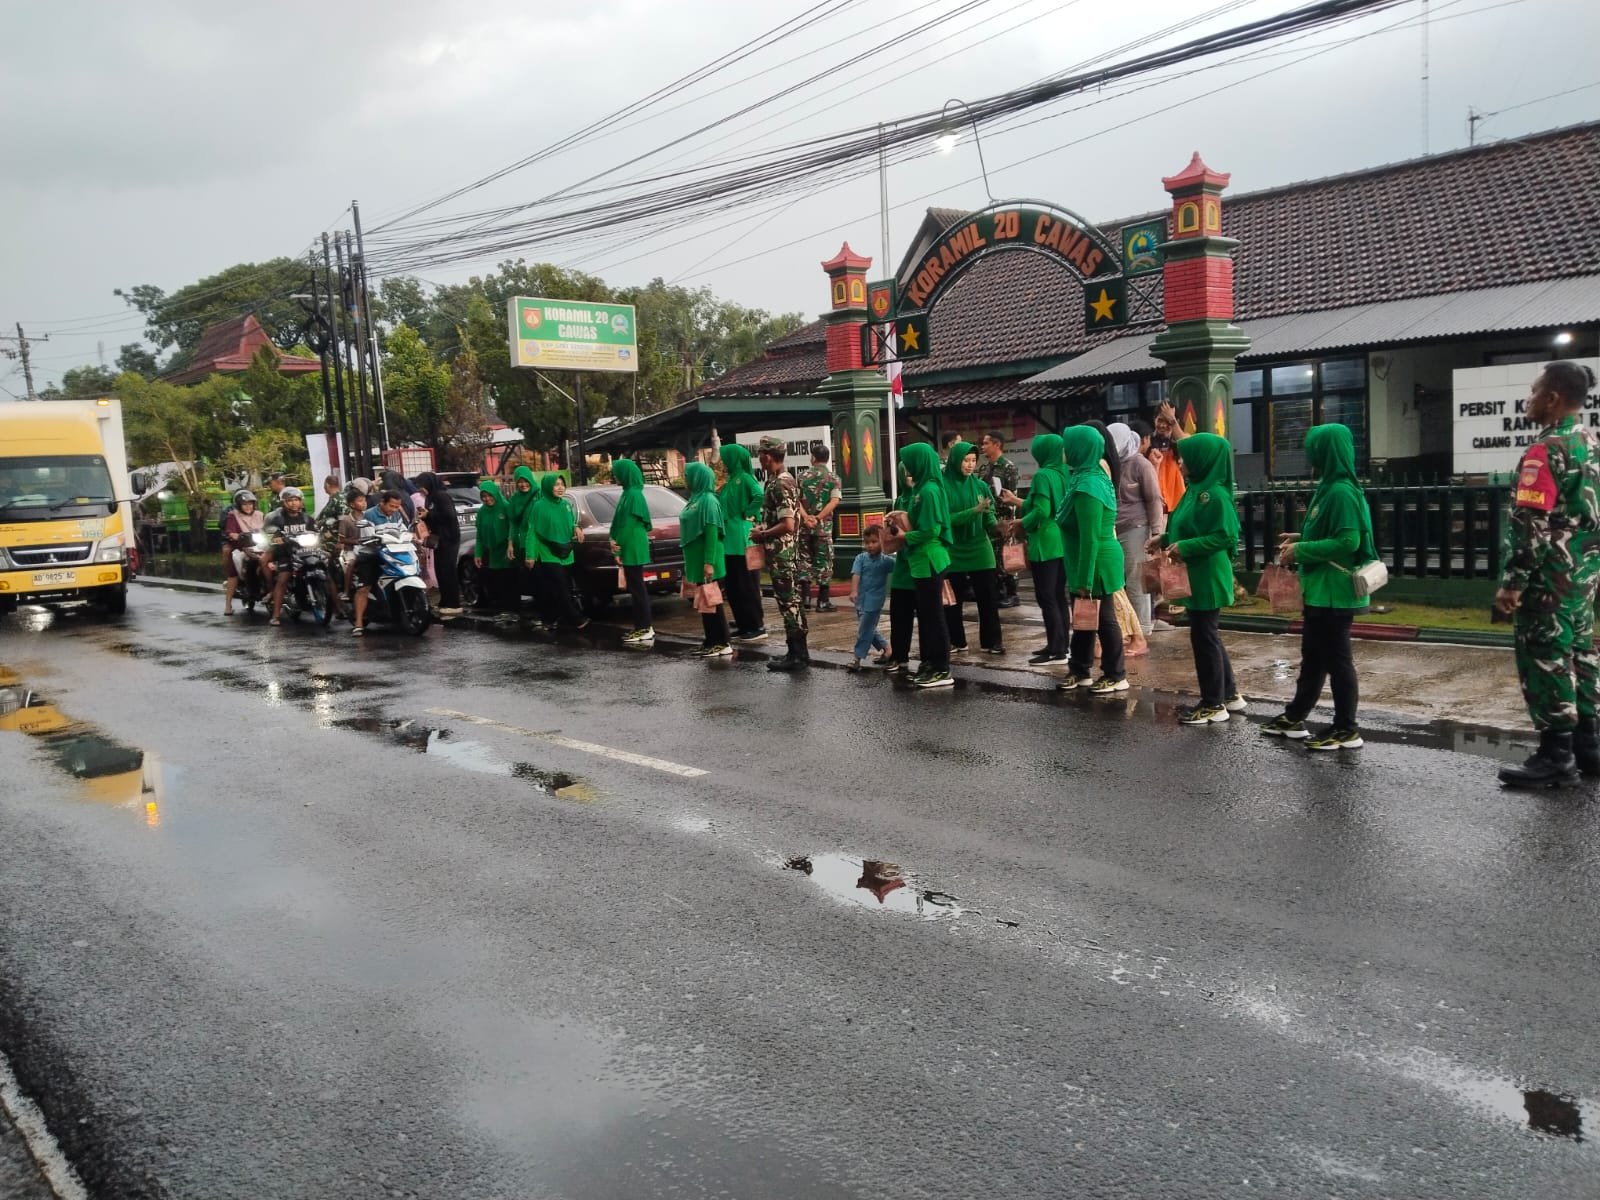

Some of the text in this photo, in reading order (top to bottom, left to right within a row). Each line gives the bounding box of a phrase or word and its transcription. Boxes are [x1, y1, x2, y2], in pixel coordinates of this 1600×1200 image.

[908, 211, 1103, 308] KORAMIL 20 CAWAS
[544, 307, 608, 325] KORAMIL 20
[558, 324, 598, 340] CAWAS
[1459, 400, 1506, 417] PERSIT
[1472, 435, 1511, 449] CABANG
